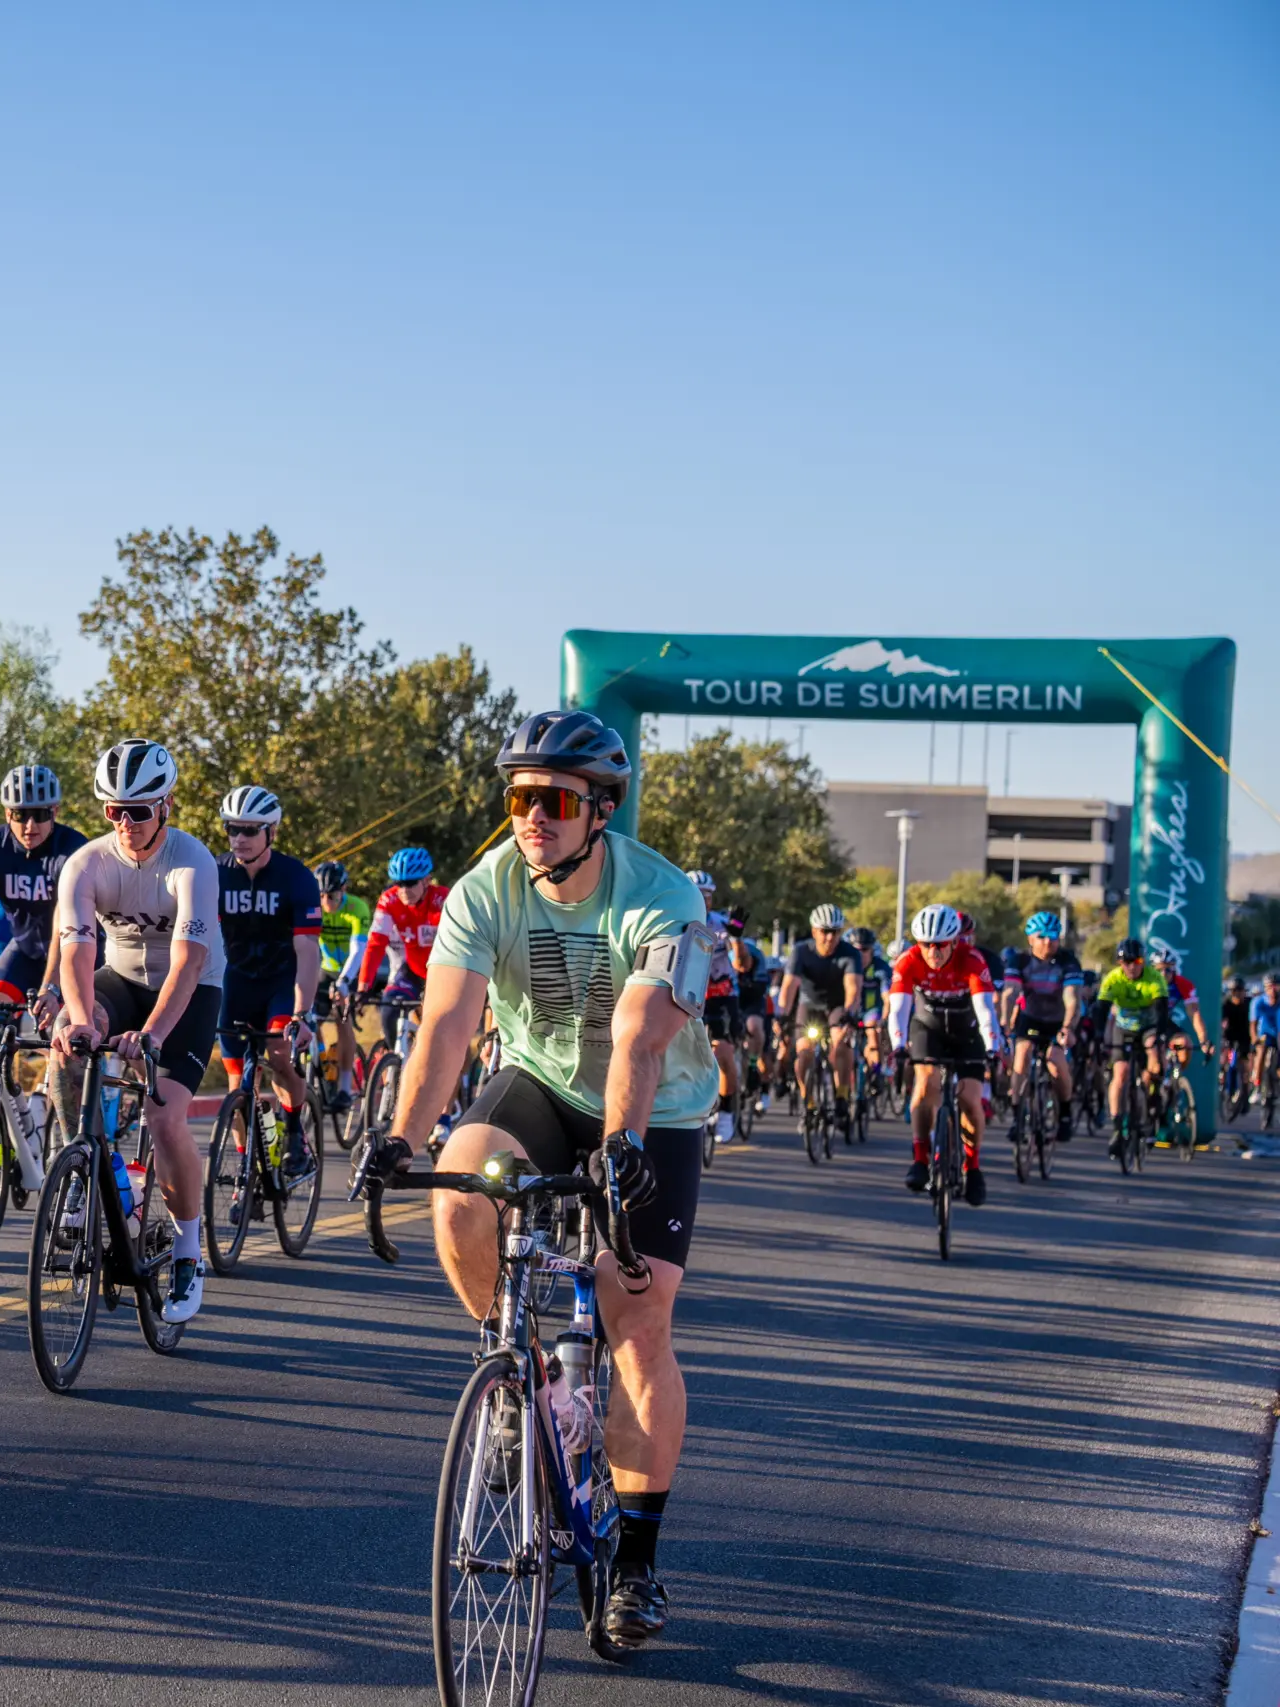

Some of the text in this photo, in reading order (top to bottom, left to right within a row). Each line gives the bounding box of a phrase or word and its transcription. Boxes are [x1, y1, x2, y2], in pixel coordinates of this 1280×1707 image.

[683, 678, 1083, 711] TOUR DE SUMMERLIN
[224, 889, 280, 916] USAF
[547, 1258, 579, 1273] TREK
[514, 1261, 532, 1330] TREK
